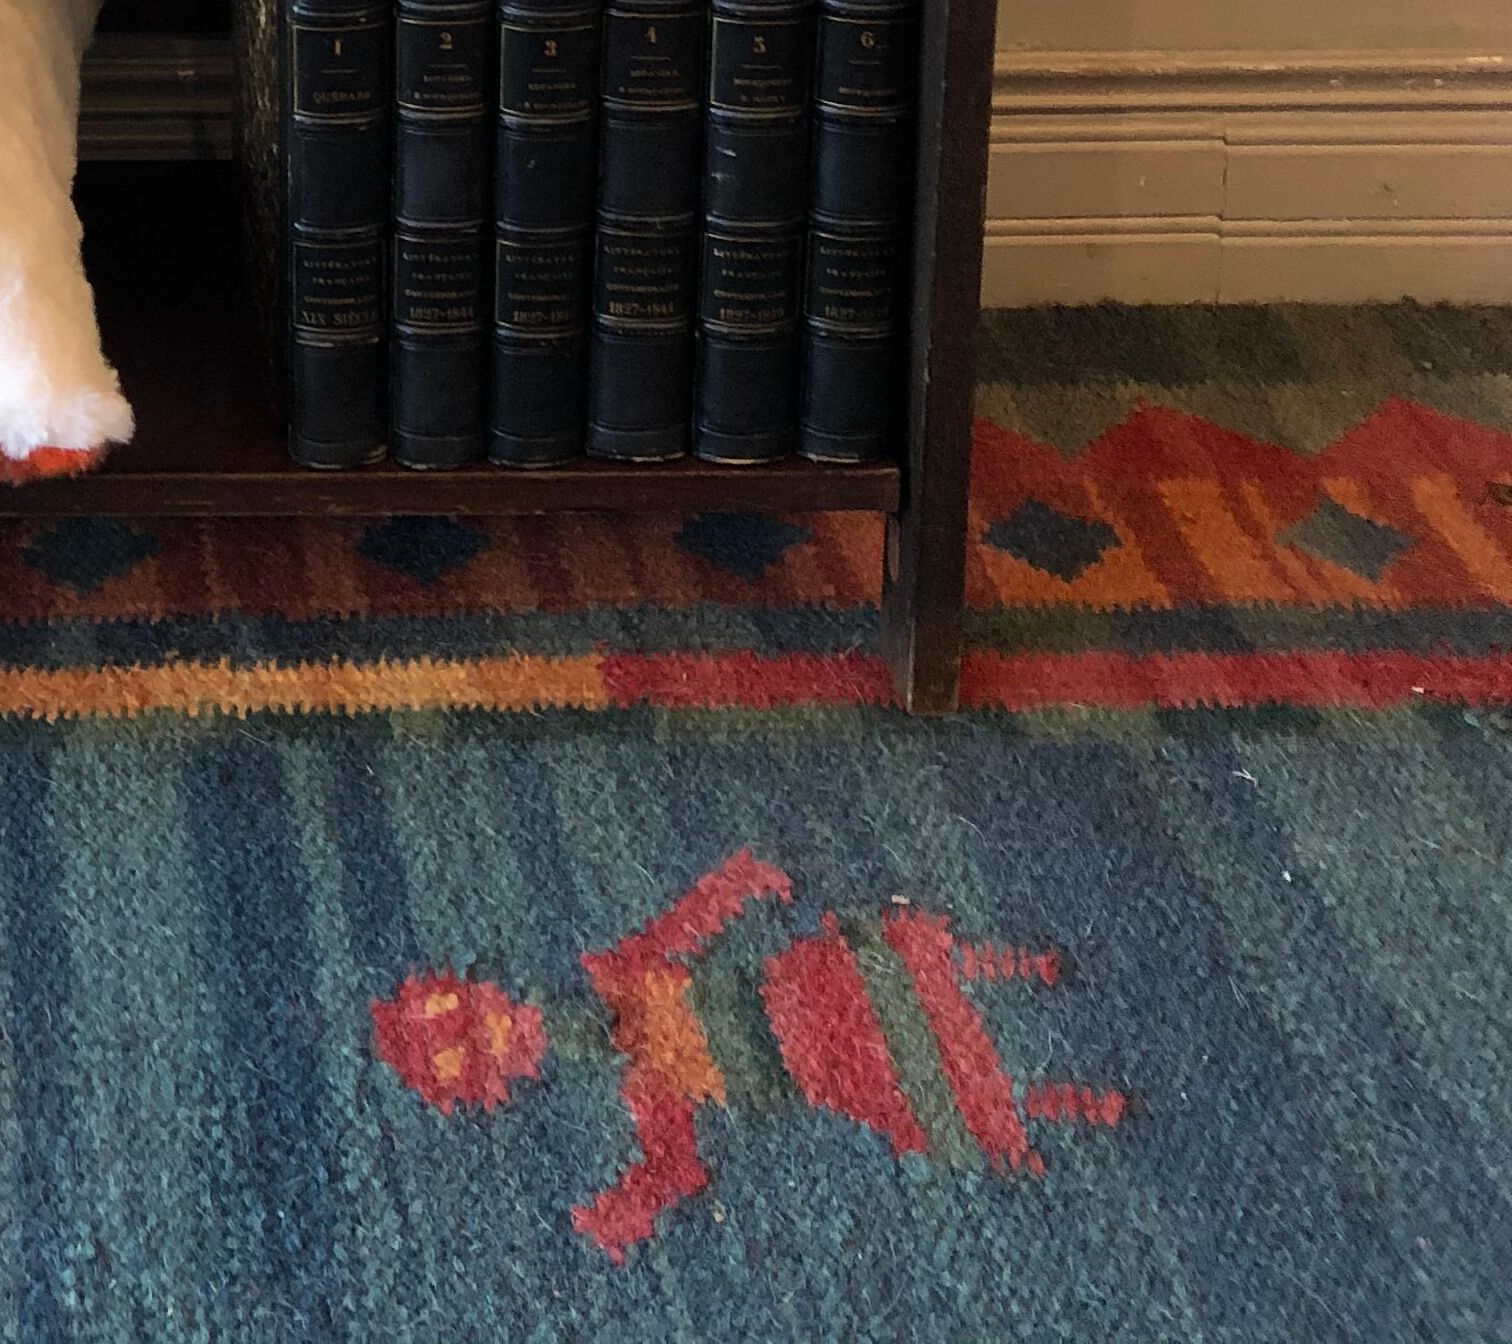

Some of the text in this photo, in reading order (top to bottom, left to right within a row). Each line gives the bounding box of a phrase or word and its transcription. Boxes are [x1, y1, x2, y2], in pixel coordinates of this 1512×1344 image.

[438, 31, 453, 51] 2
[543, 38, 559, 58] 3
[752, 33, 767, 53] 5
[860, 30, 875, 49] 6
